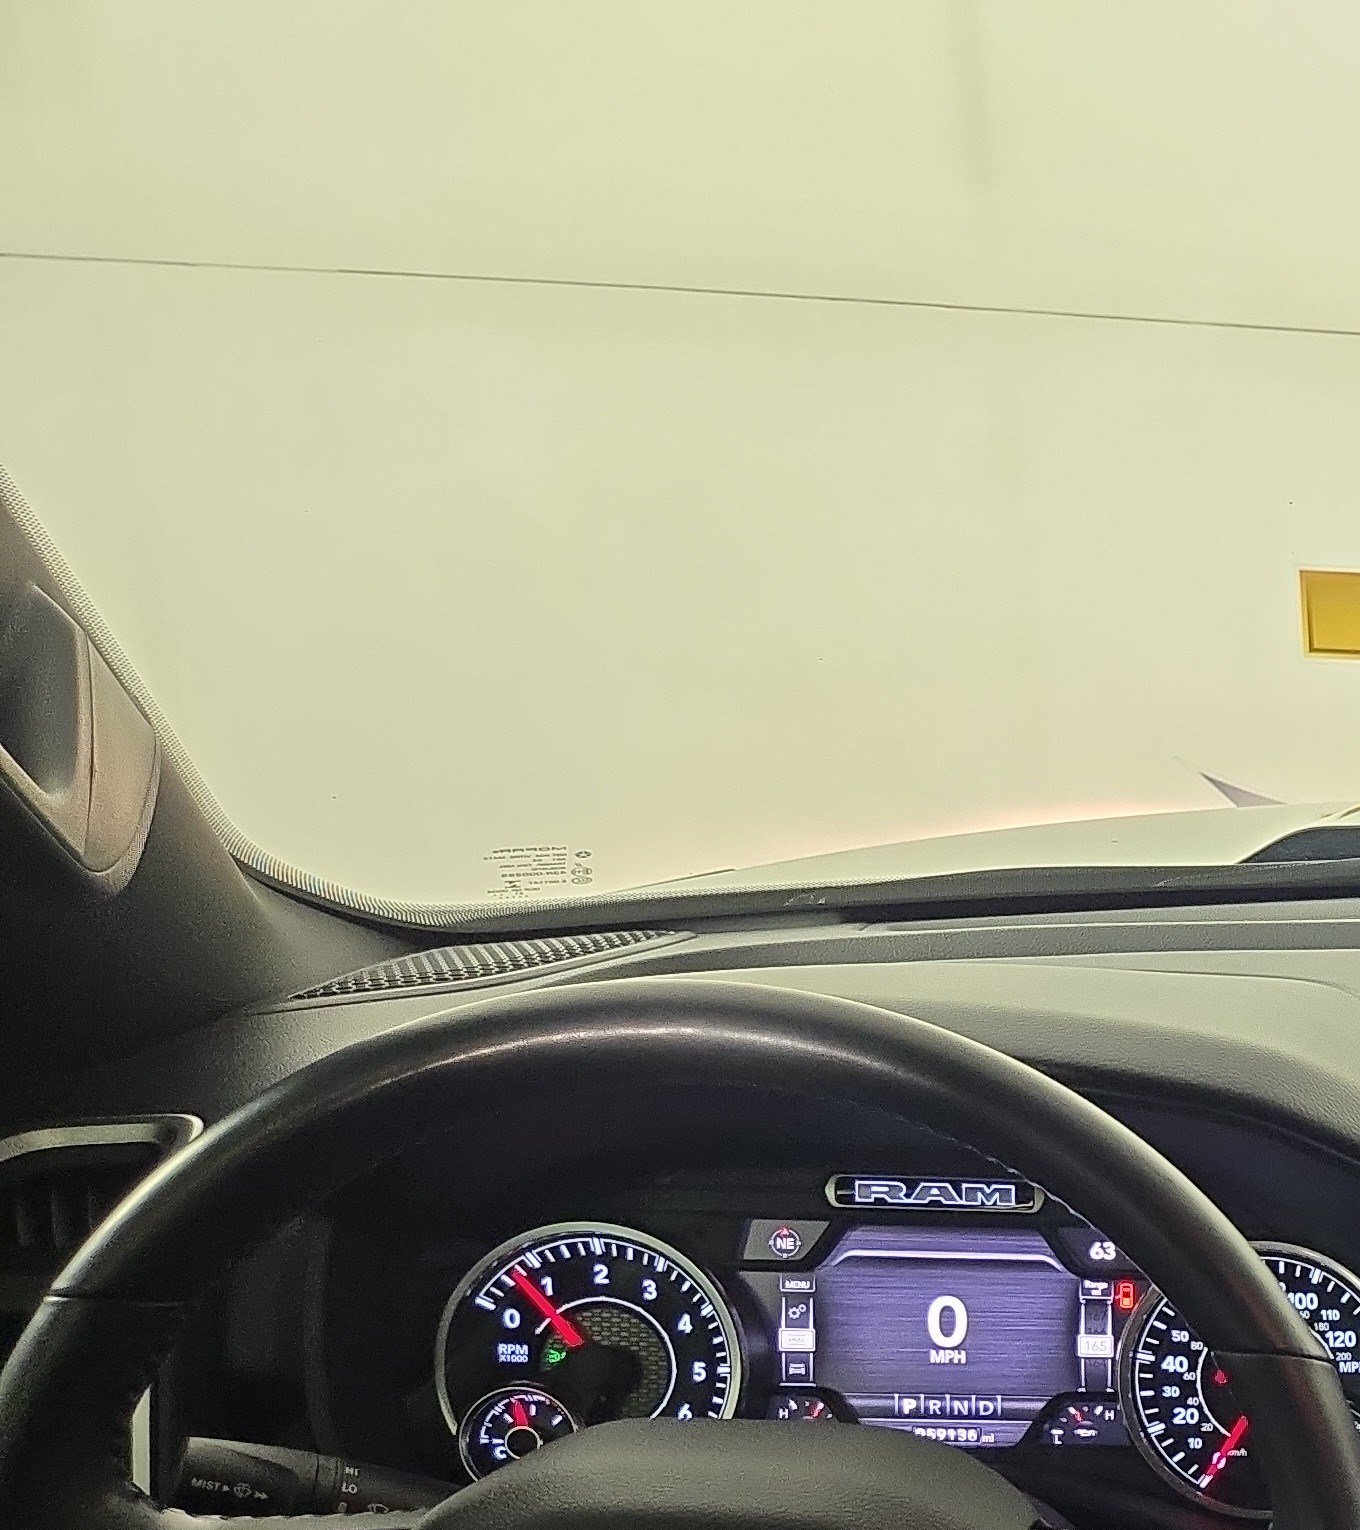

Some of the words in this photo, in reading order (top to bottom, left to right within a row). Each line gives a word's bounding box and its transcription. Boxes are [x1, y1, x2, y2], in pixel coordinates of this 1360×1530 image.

[855, 1178, 1016, 1206] RAM
[775, 1236, 796, 1251] NE
[1089, 1242, 1116, 1261] 63
[594, 1264, 610, 1285] 2
[541, 1276, 553, 1294] 1
[642, 1279, 657, 1300] 3
[503, 1309, 520, 1329] 0
[677, 1312, 693, 1334] 4
[926, 1295, 969, 1349] 0
[1320, 1309, 1341, 1321] 110
[1171, 1329, 1190, 1343] 50
[1325, 1330, 1357, 1348] 120
[498, 1343, 529, 1357] RPM
[1084, 1340, 1107, 1352] 165
[929, 1348, 967, 1365] MPH
[1161, 1355, 1189, 1373] 40
[1335, 1352, 1352, 1361] 200
[692, 1362, 707, 1383] 5
[1183, 1371, 1196, 1381] 60
[1162, 1385, 1181, 1398] 30
[902, 1398, 917, 1415] P
[929, 1399, 942, 1415] R
[953, 1400, 969, 1416] N
[979, 1400, 995, 1416] D
[1186, 1397, 1200, 1407] 40
[677, 1404, 693, 1421] 6
[778, 1407, 789, 1420] H
[1104, 1409, 1115, 1421] H
[1172, 1407, 1200, 1425] 20
[1200, 1422, 1214, 1432] 20
[1187, 1437, 1203, 1449] 10
[493, 1445, 508, 1460] C
[340, 1480, 358, 1494] LO
